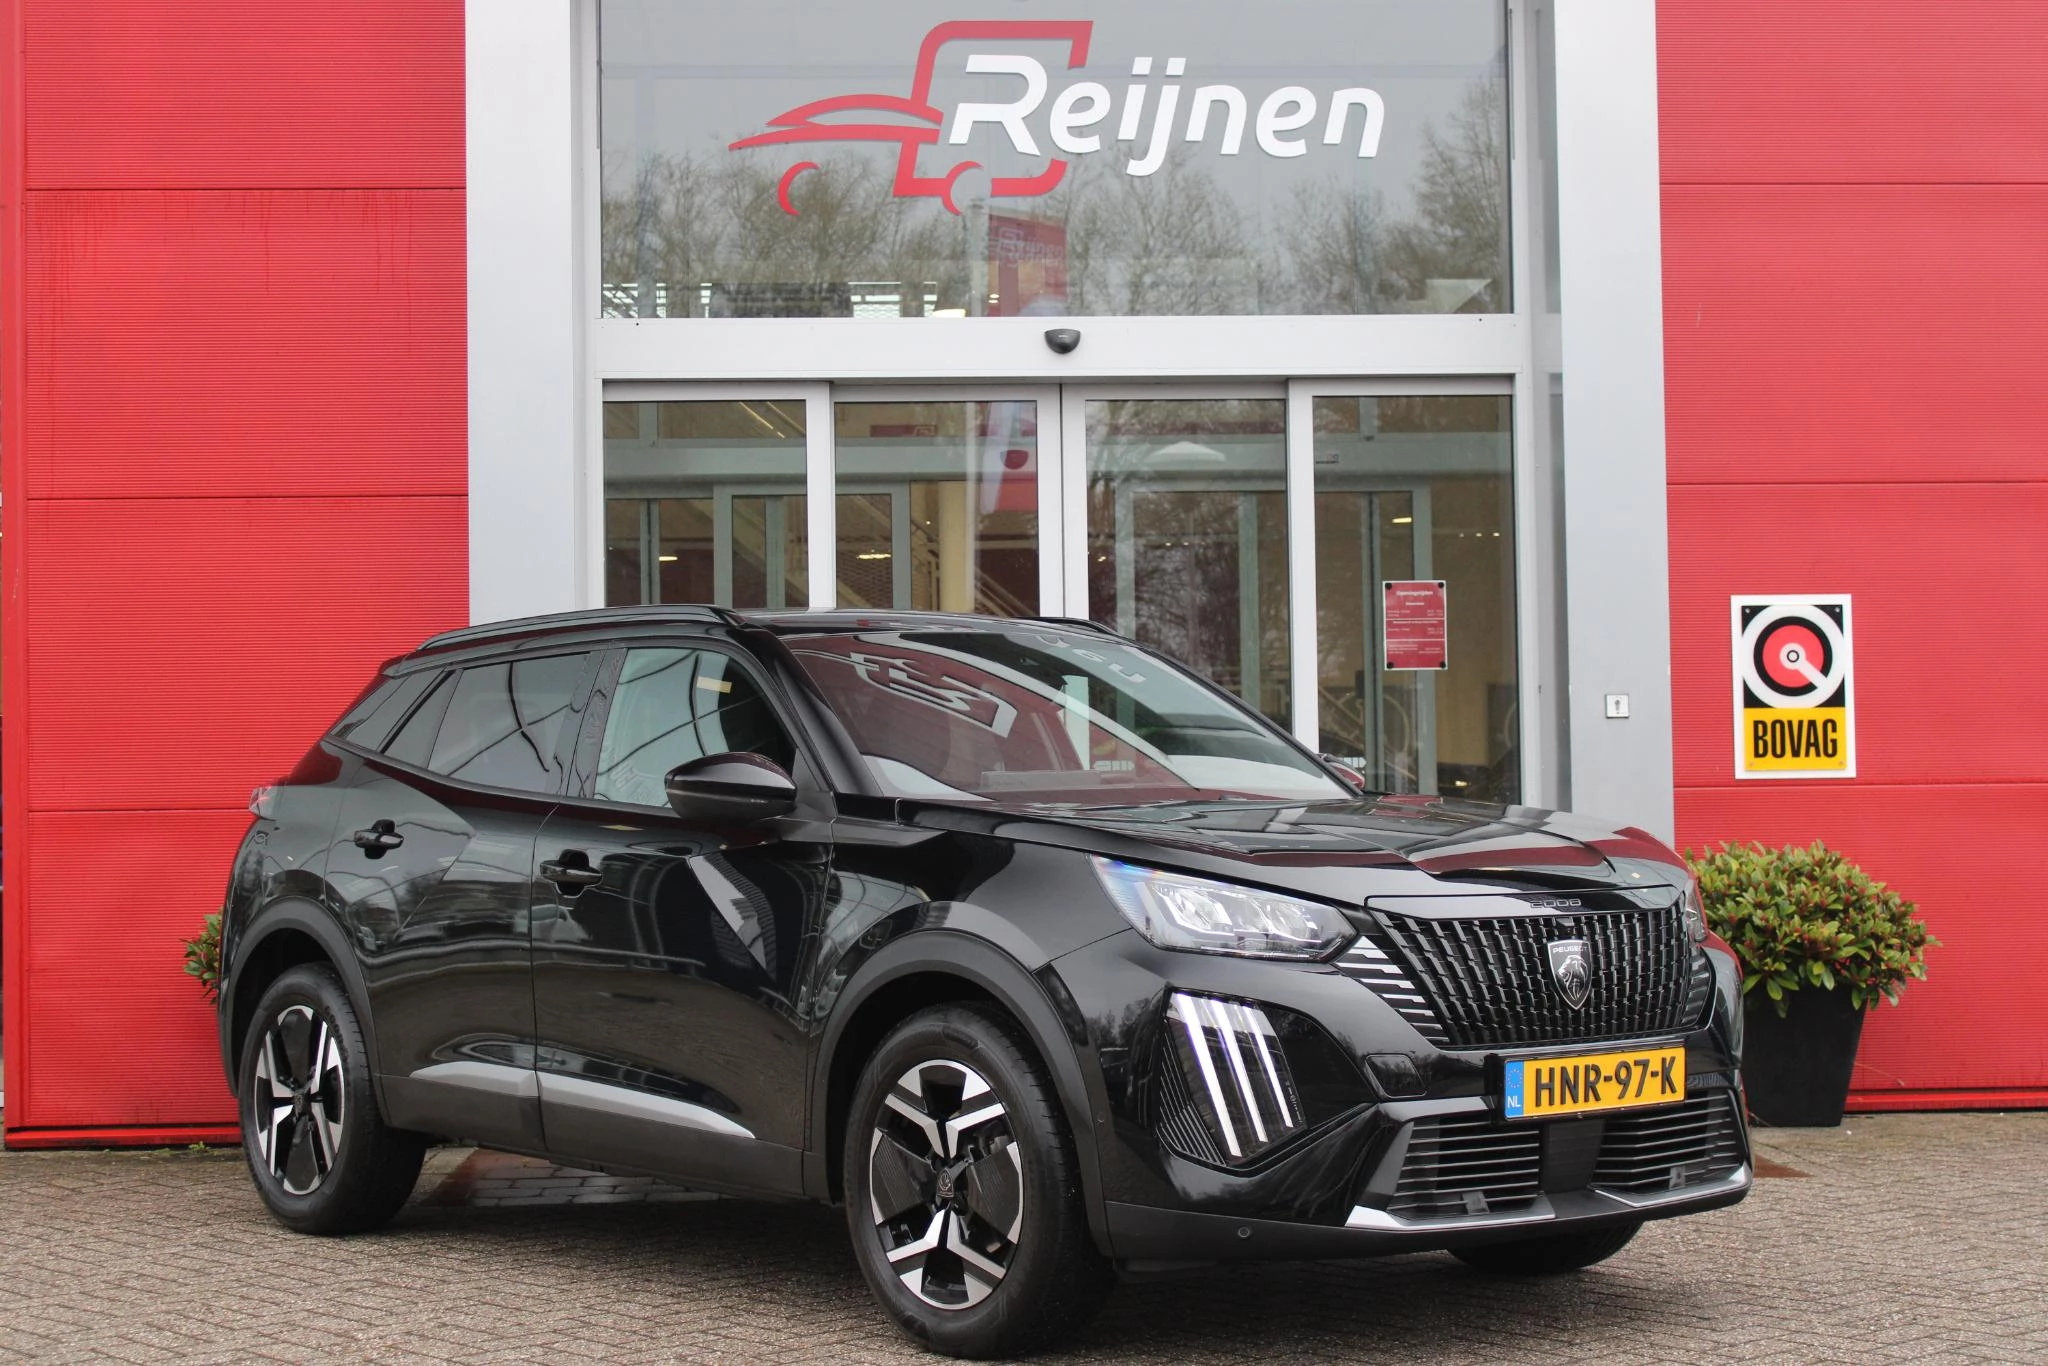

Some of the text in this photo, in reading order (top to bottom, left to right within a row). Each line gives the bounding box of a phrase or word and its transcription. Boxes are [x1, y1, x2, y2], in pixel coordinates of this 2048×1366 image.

[948, 54, 1385, 177] Reijnen
[1753, 718, 1838, 758] BOVAG
[1530, 899, 1582, 908] 2008
[1535, 1056, 1677, 1107] HNR-97-K
[1507, 1096, 1521, 1108] NL
